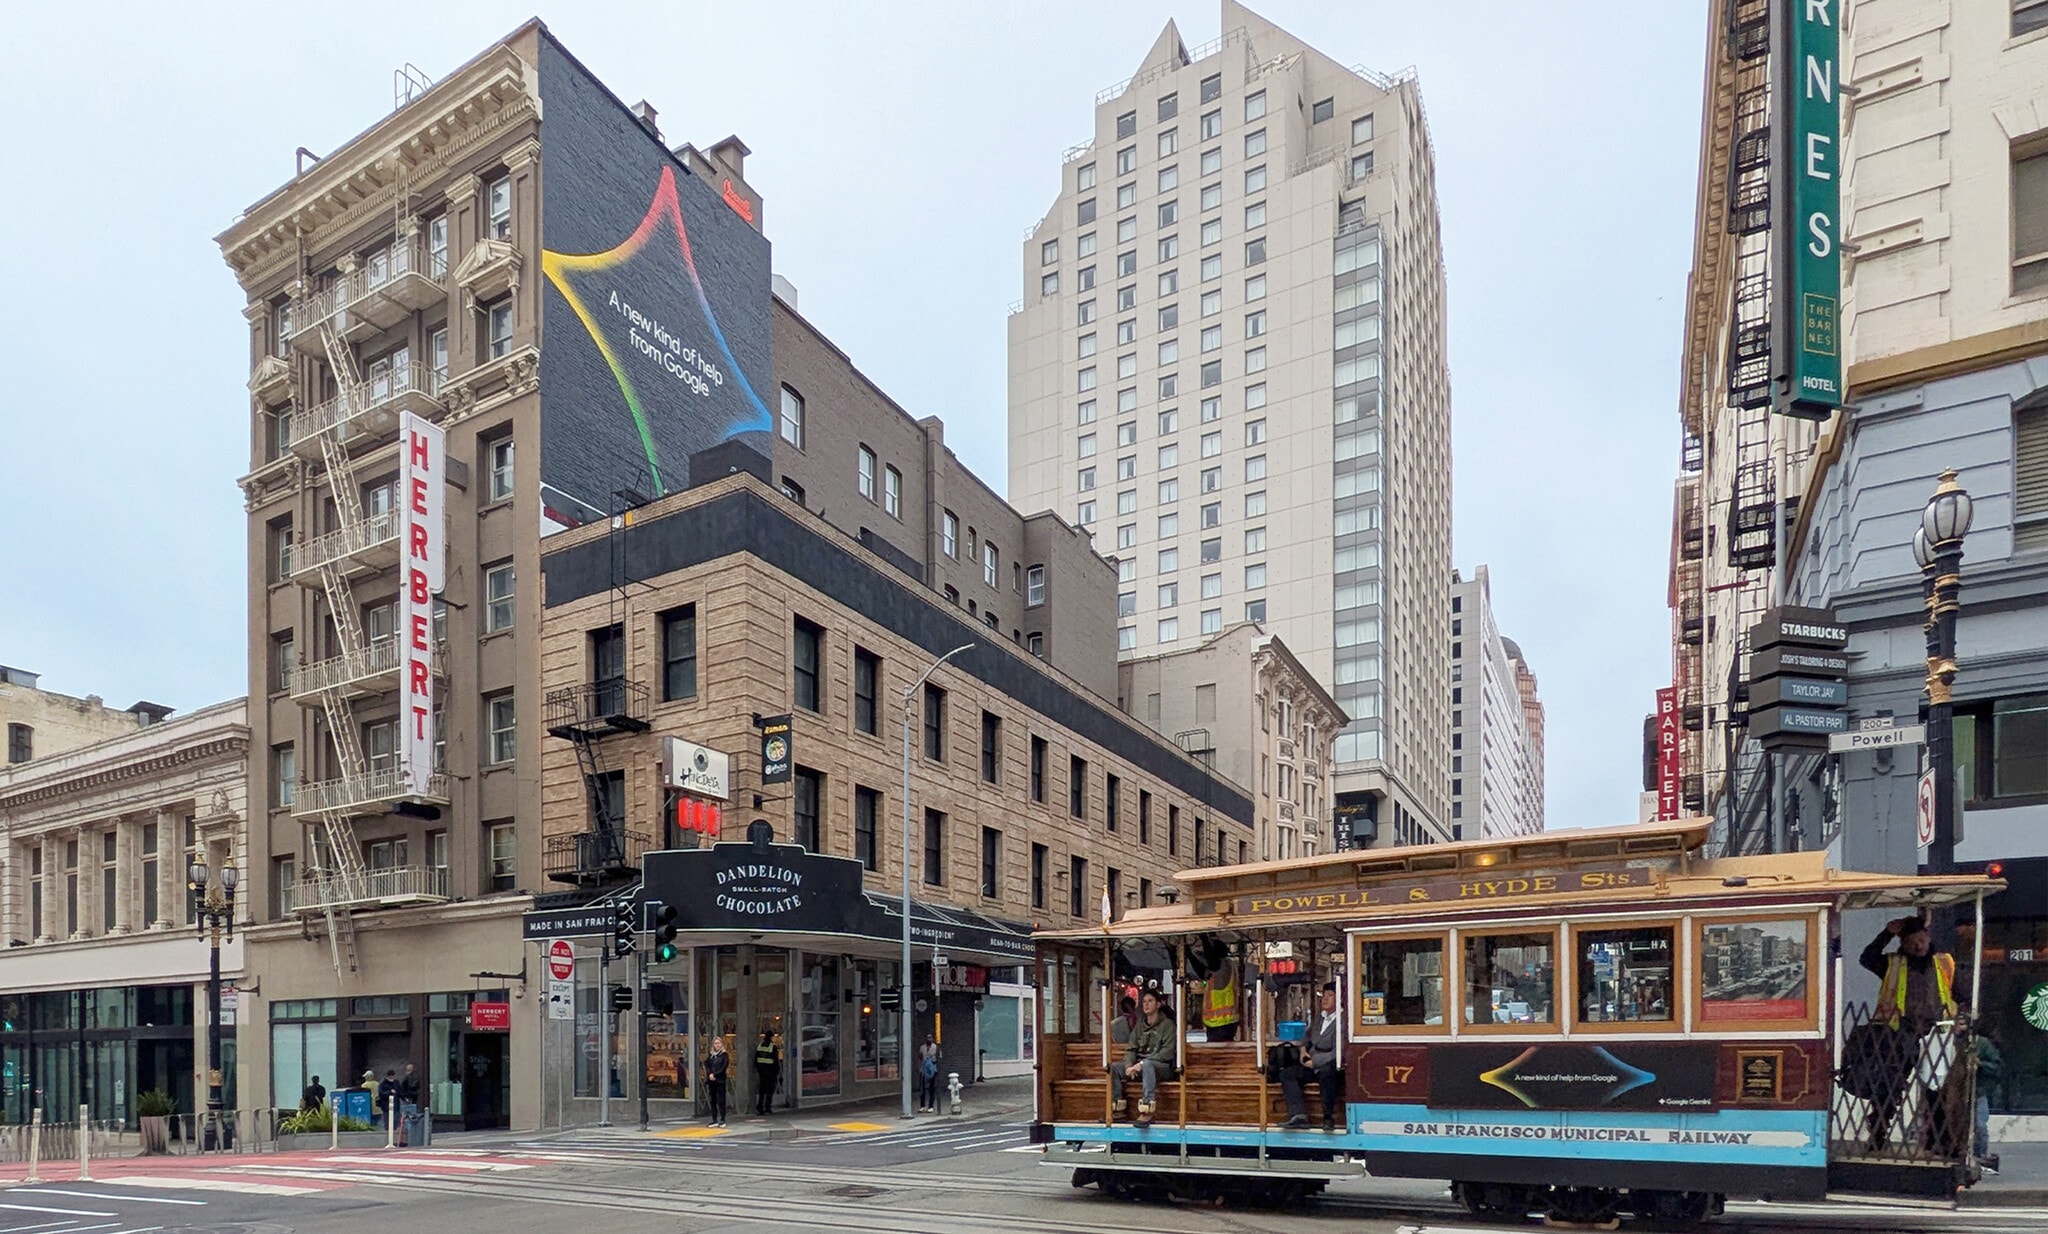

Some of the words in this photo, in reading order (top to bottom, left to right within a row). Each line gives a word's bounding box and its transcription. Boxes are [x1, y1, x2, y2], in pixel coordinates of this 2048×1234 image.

[1809, 304, 1832, 317] THE
[1808, 319, 1832, 332] BAR
[609, 290, 621, 312] A
[623, 303, 651, 333] new
[654, 320, 680, 355] kind
[683, 347, 696, 365] of
[698, 353, 723, 387] help
[1808, 333, 1832, 346] NES
[629, 327, 661, 365] from
[664, 352, 709, 396] Google
[1803, 376, 1836, 392] HOTEL
[410, 431, 428, 740] HERBERT
[1781, 623, 1846, 640] STARBUCKS
[1781, 654, 1799, 665] JOSH'S
[1792, 685, 1821, 697] TAYLOR
[1821, 687, 1835, 698] JAY
[1785, 714, 1795, 725] AL
[1796, 715, 1825, 727] PASTOR
[1826, 717, 1842, 728] PAPI
[1863, 720, 1880, 729] 200
[1852, 731, 1903, 746] Powell
[716, 865, 802, 886] DANDELION
[1251, 892, 1379, 912] POWELL
[1409, 887, 1429, 900] &
[1460, 877, 1557, 897] HYDE
[716, 894, 801, 914] CHOCOLATE
[530, 922, 552, 931] MADE
[555, 920, 563, 929] IN
[566, 919, 582, 929] SAN
[2010, 949, 2033, 960] 201
[1386, 1066, 1414, 1083] 17
[1559, 1074, 1573, 1083] help
[1592, 1074, 1617, 1083] Google
[1403, 1123, 1438, 1135] SAN
[1445, 1124, 1547, 1139] FRANCISCO
[1551, 1128, 1651, 1143] MUNICIPAL
[1668, 1131, 1752, 1145] RAILWAY
